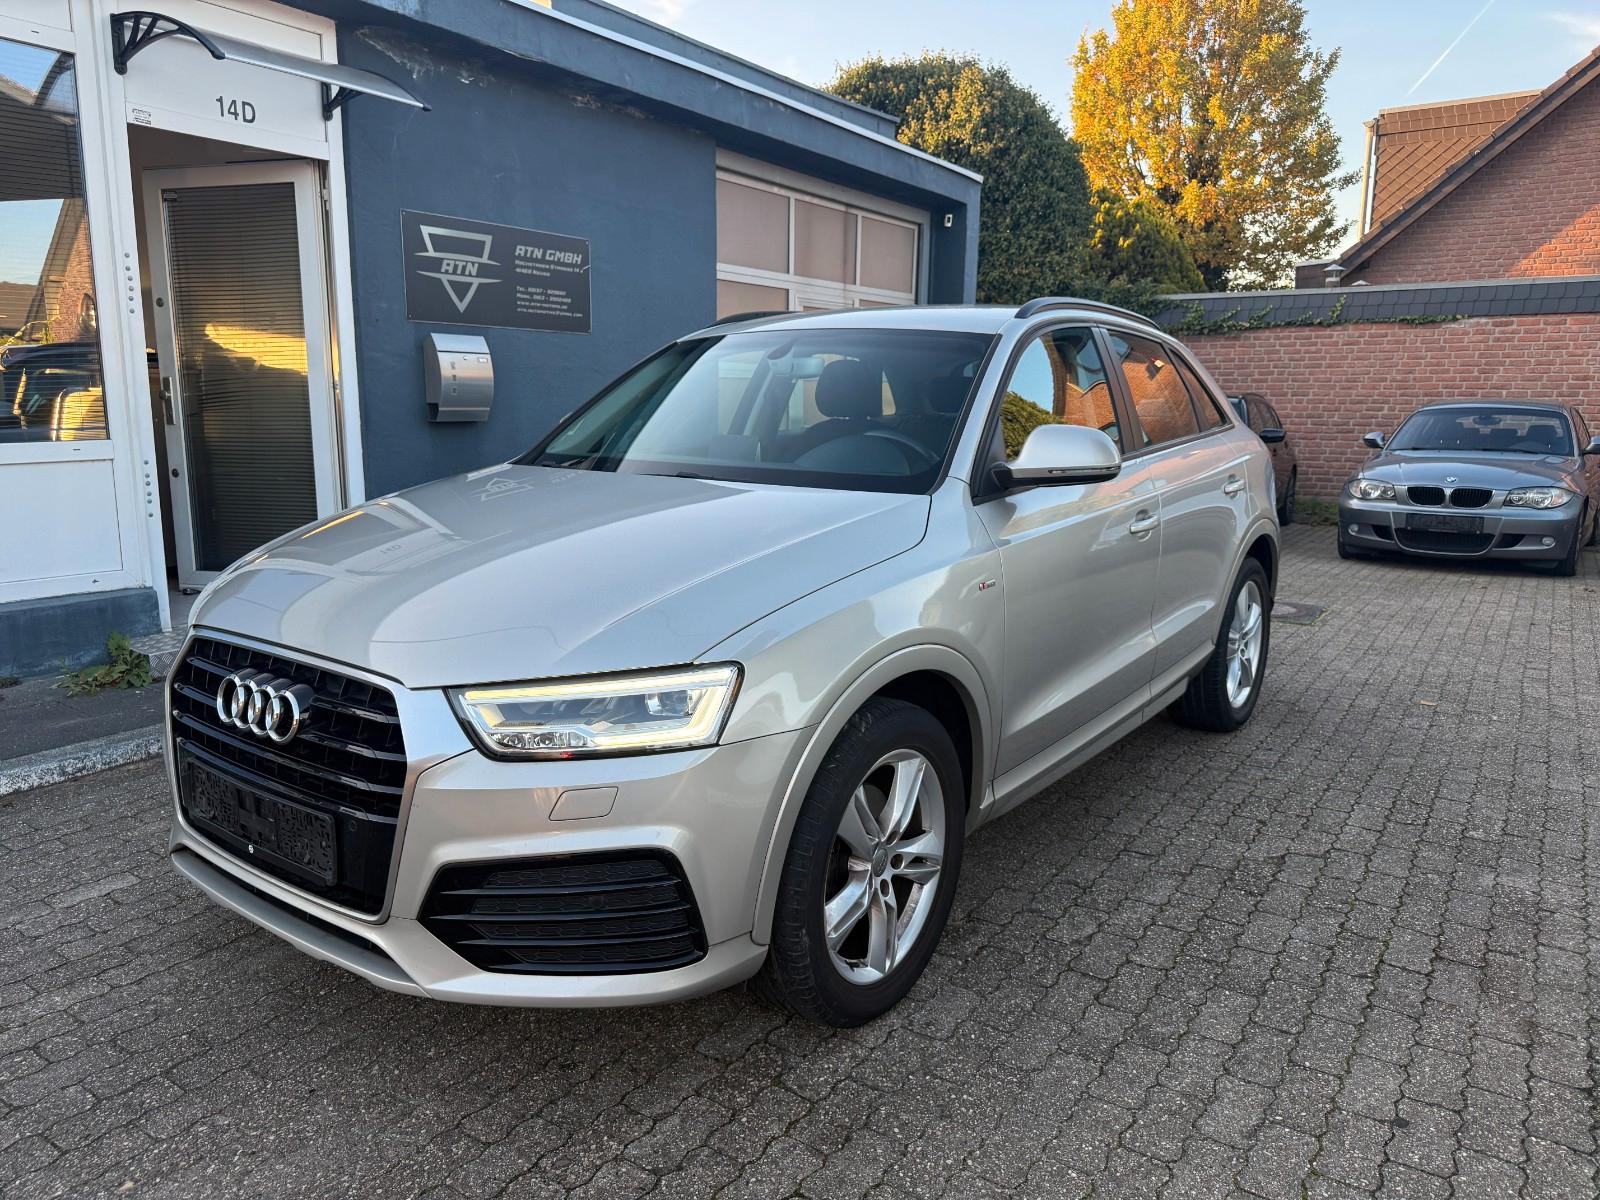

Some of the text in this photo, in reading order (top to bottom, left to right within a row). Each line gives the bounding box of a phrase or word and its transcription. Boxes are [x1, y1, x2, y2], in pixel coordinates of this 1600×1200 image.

[215, 95, 256, 123] 14D
[515, 245, 542, 259] ATN
[440, 260, 479, 276] ATN
